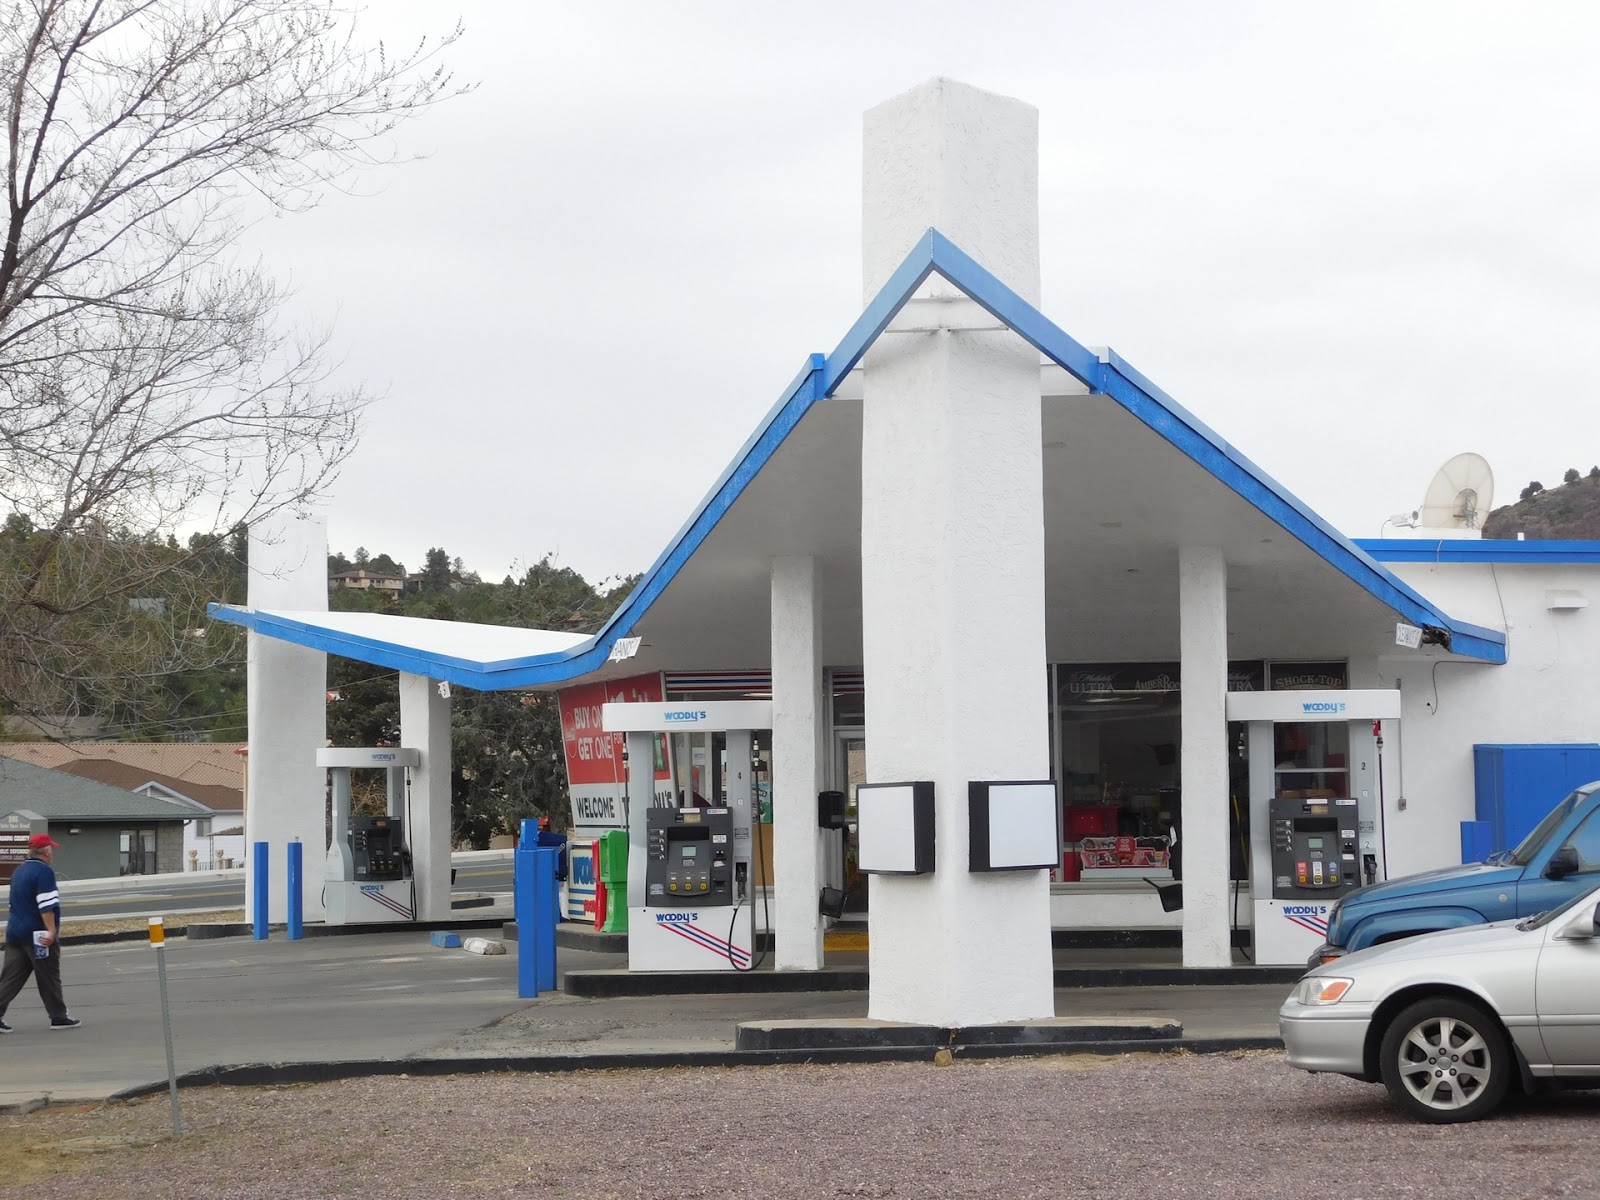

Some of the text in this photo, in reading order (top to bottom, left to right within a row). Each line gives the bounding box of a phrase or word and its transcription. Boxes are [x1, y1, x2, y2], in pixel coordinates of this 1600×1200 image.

[1302, 702, 1346, 713] WOODY'S
[573, 705, 603, 730] BUY ON
[664, 711, 706, 722] WOODY'S
[577, 735, 613, 760] GET ONE
[1361, 761, 1366, 771] 2
[737, 771, 742, 780] 4
[575, 797, 615, 819] WELCOME
[1365, 841, 1371, 849] 2
[1283, 905, 1327, 916] WOODY'S
[656, 912, 698, 923] WOODY'S
